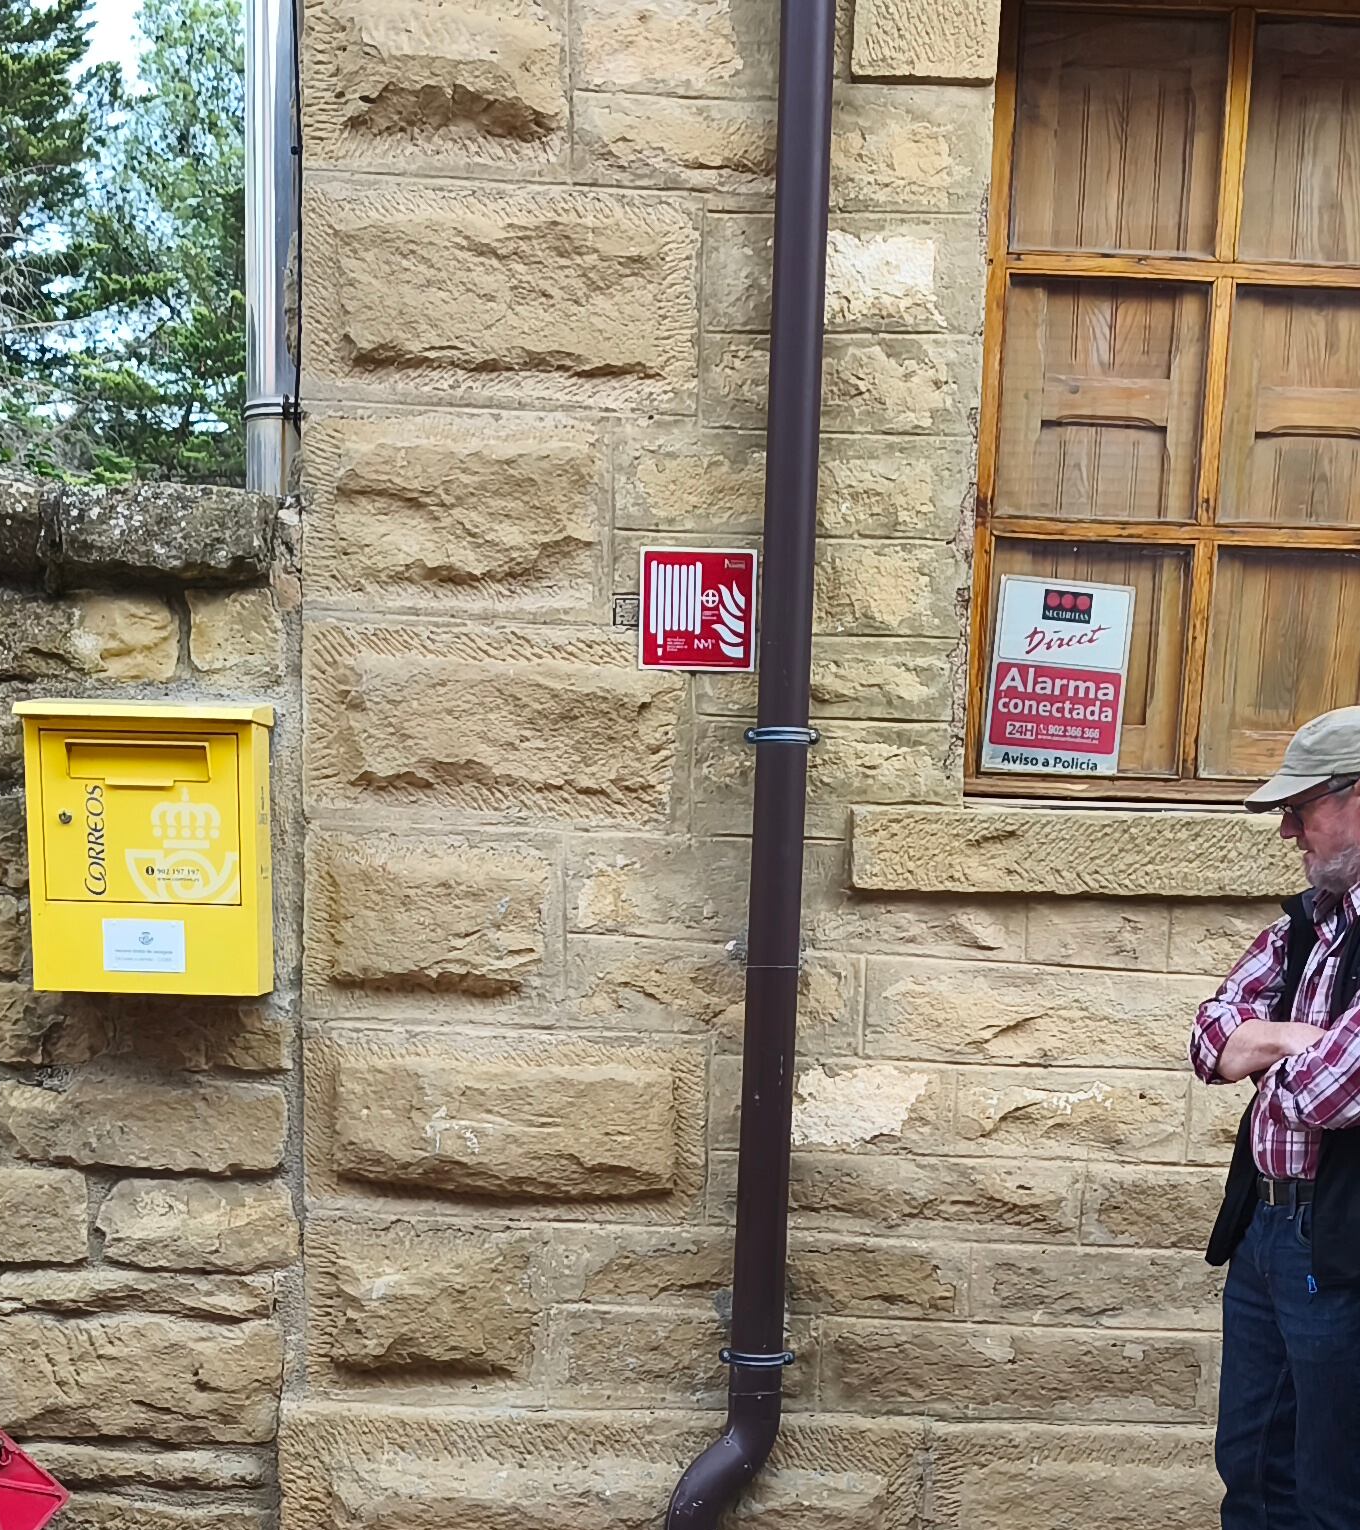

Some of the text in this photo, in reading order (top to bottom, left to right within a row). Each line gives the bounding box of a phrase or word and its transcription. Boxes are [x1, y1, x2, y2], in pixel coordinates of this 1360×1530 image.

[1045, 609, 1089, 621] SECURITAS
[1024, 624, 1112, 654] Direct
[999, 667, 1115, 701] Alarma
[997, 696, 1113, 722] conectada
[1007, 723, 1035, 738] 24H
[1001, 751, 1098, 772] Aviso a Policía
